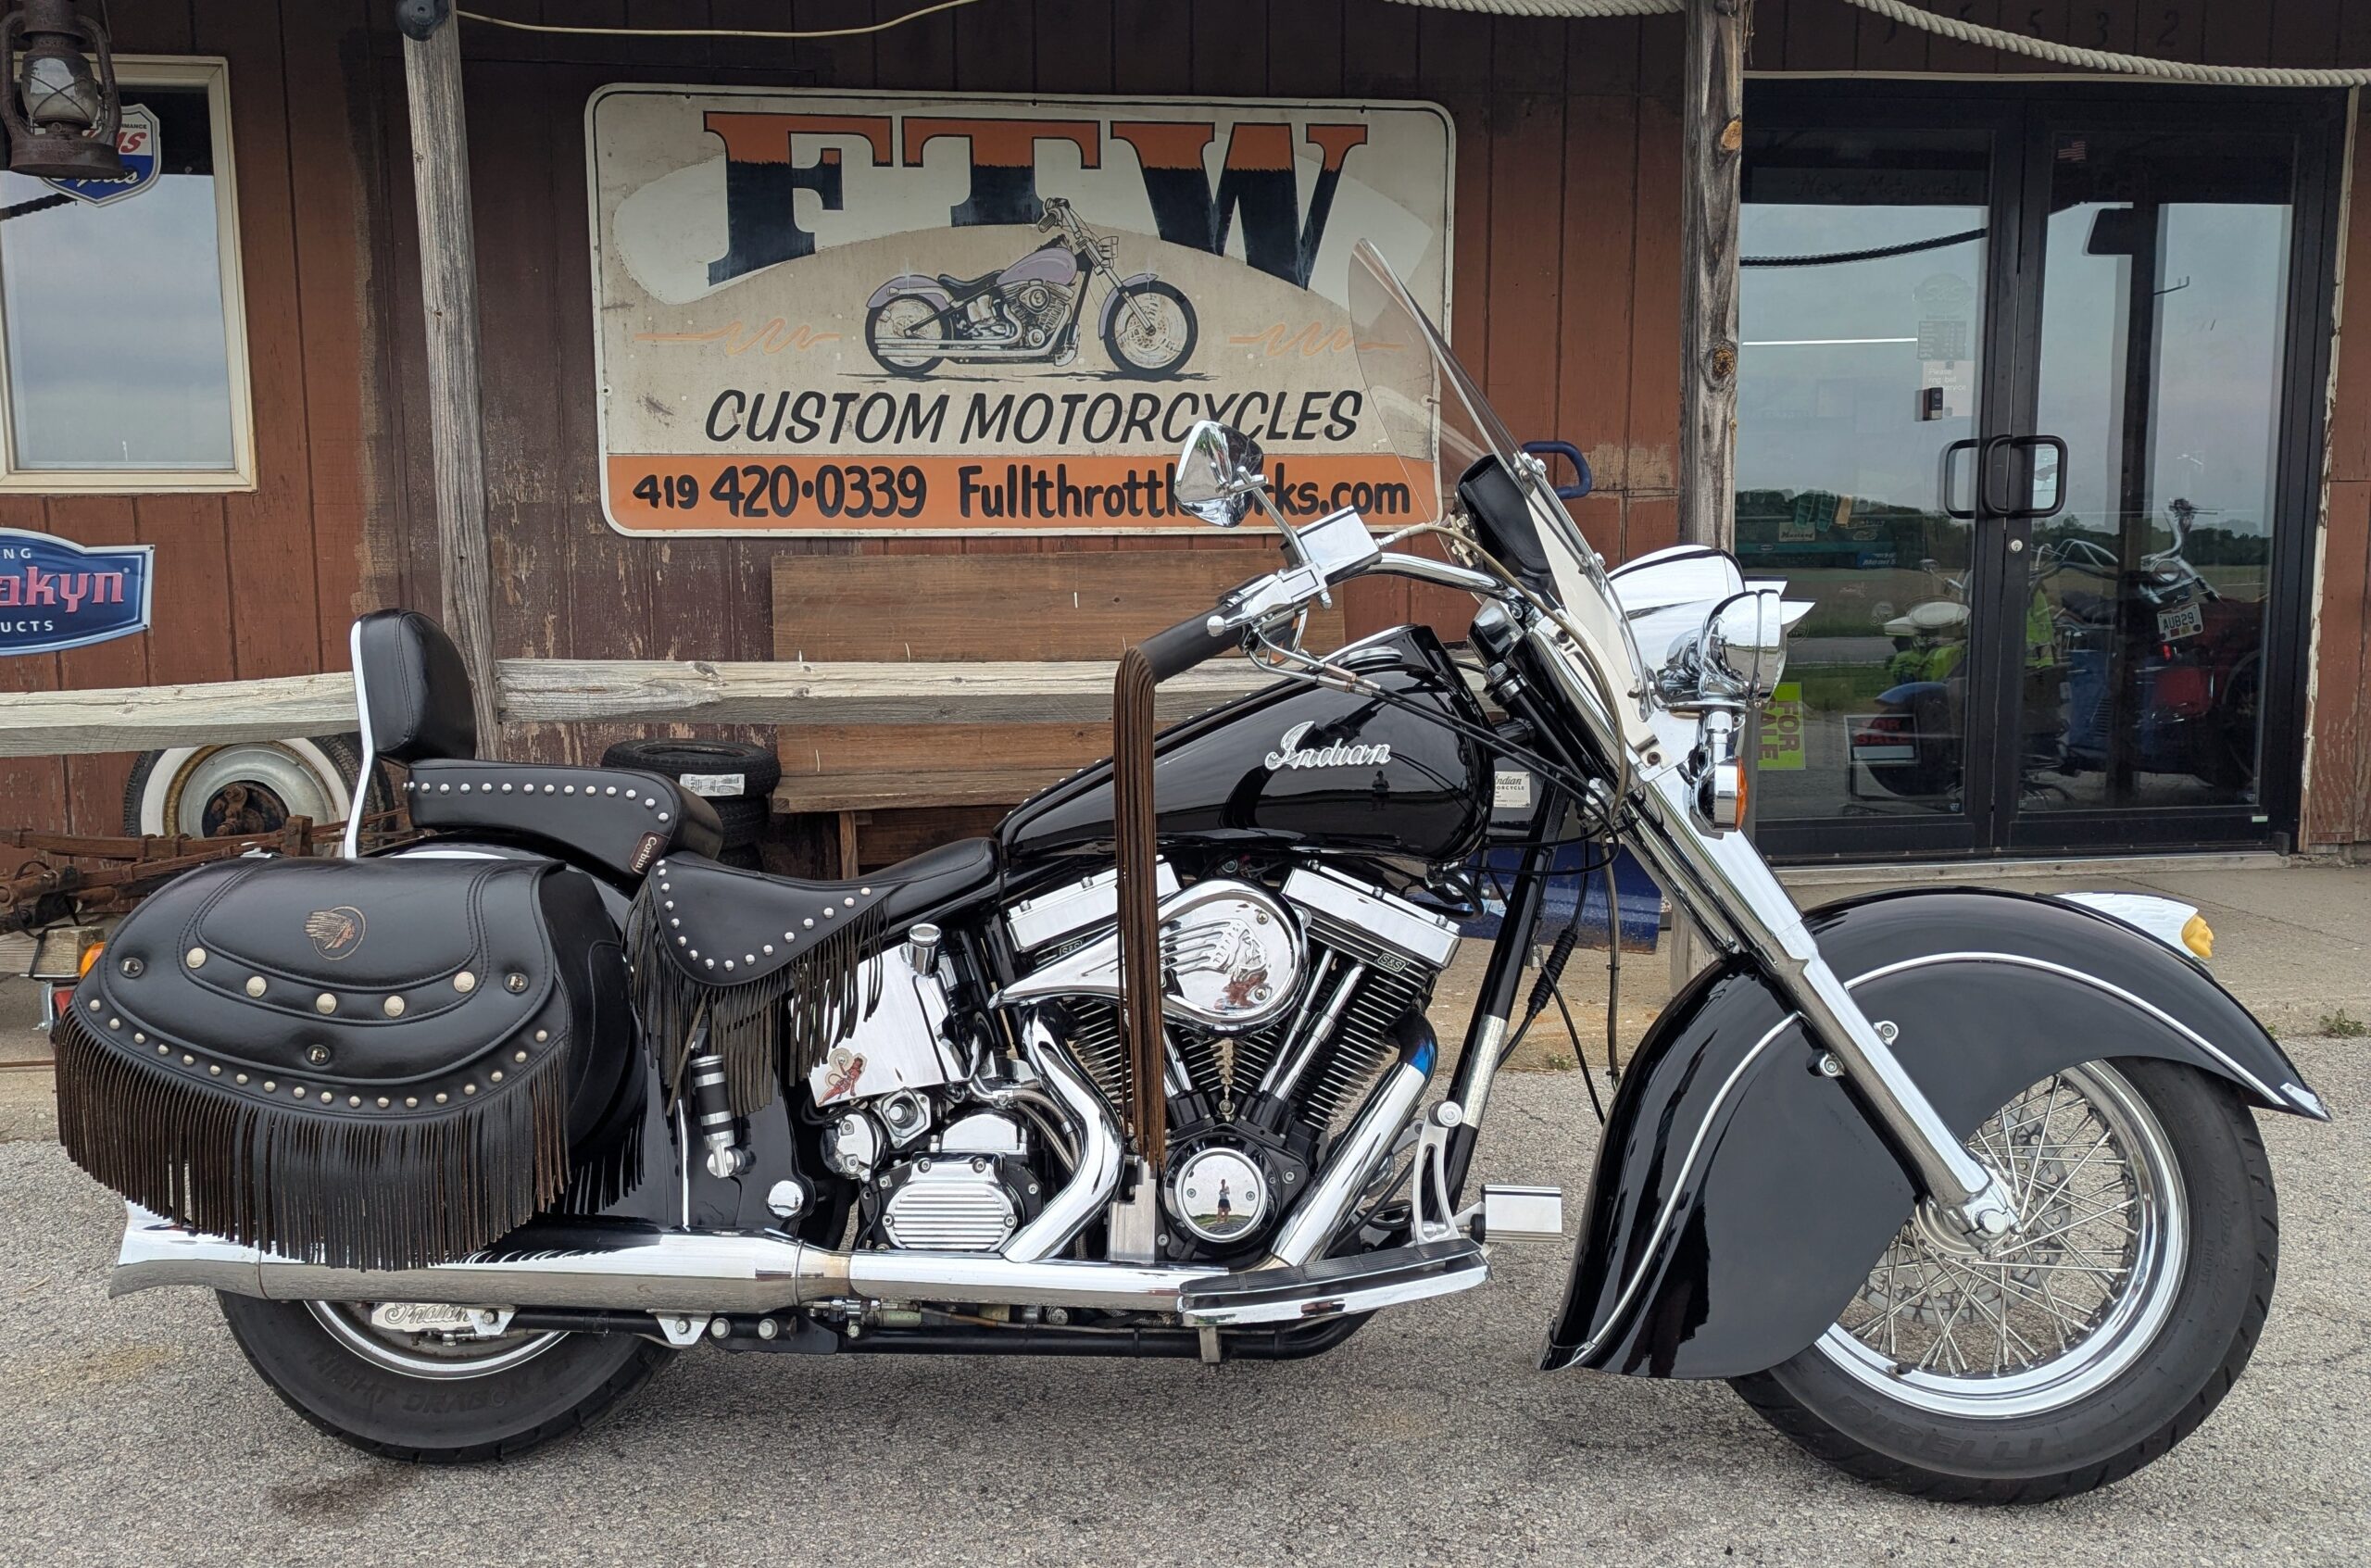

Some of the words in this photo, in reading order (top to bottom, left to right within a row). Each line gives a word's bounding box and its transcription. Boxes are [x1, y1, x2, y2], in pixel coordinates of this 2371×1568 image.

[704, 112, 1367, 291] FTW
[706, 390, 950, 444] CUSTOM
[960, 390, 1362, 445] MOTORCYCLES
[633, 473, 698, 508] 419
[959, 462, 1411, 519] Fullthrottlrks.com
[2164, 611, 2195, 632] AUB29
[1264, 721, 1392, 771] Indian
[1777, 700, 1800, 752] FOR
[1496, 775, 1523, 785] ndian
[634, 836, 658, 869] Corbin
[1380, 955, 1402, 970] S&S
